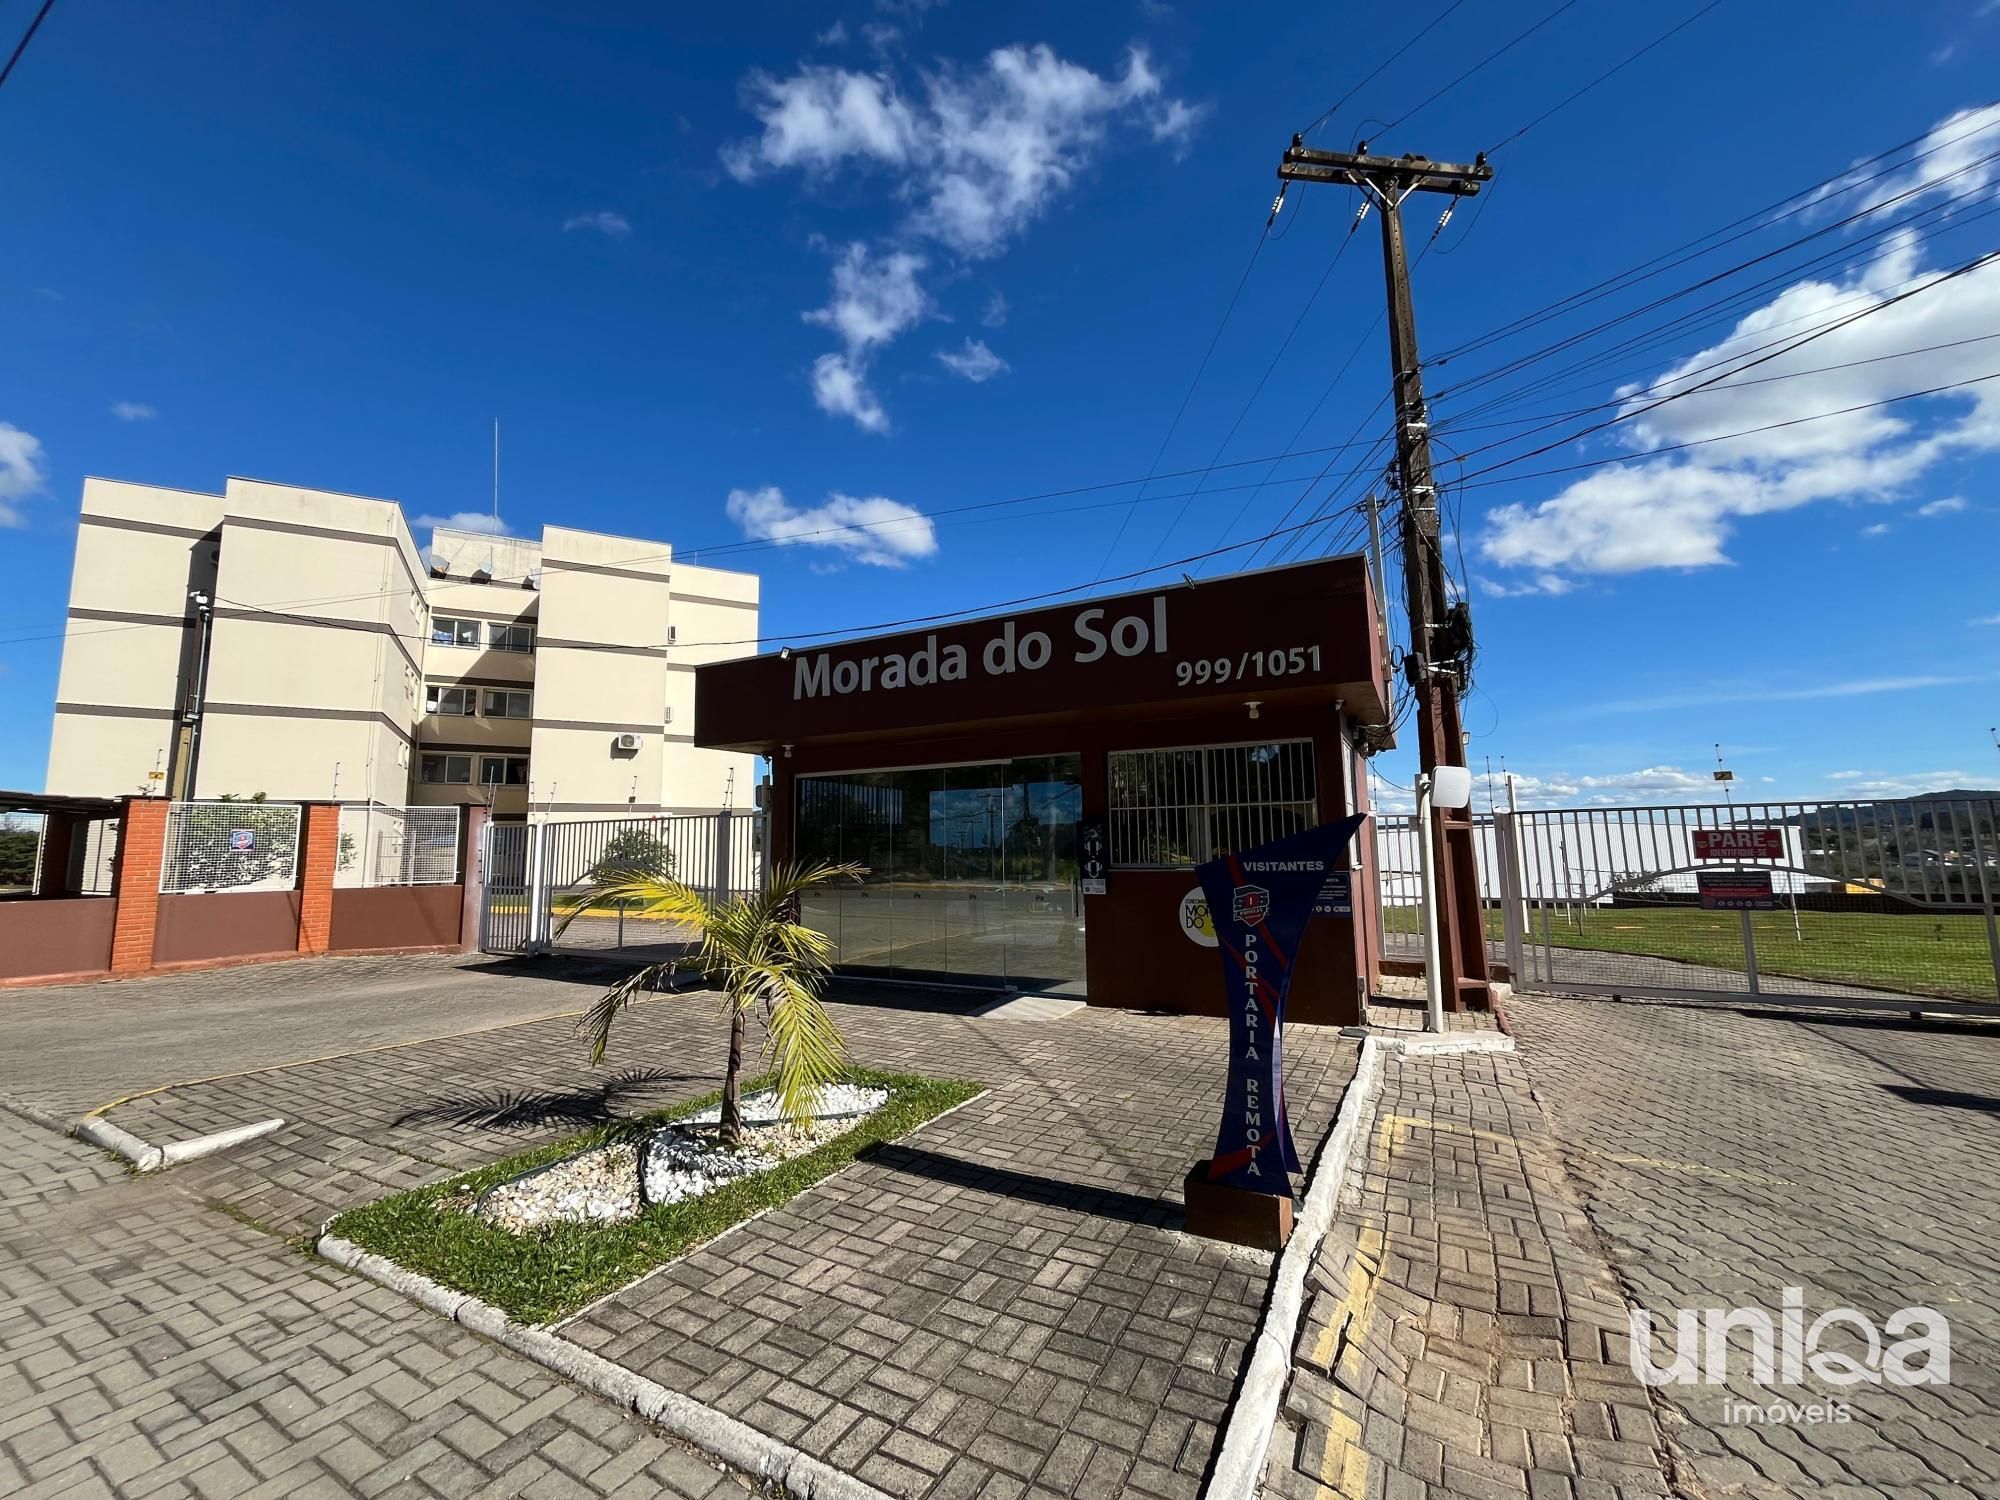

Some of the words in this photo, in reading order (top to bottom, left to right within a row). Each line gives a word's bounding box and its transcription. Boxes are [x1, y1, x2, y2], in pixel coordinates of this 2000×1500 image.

[793, 634, 967, 700] Morada
[983, 621, 1052, 675] do
[1074, 596, 1168, 663] Sol
[1176, 645, 1321, 687] 999/1051
[1708, 831, 1767, 848] PARE
[1710, 848, 1768, 857] IDENTIFIQUE-SE
[1243, 861, 1325, 872] VISITANTES
[1186, 916, 1205, 929] DO
[1244, 934, 1260, 1061] PORTARIA
[1245, 1078, 1262, 1177] REMOTA
